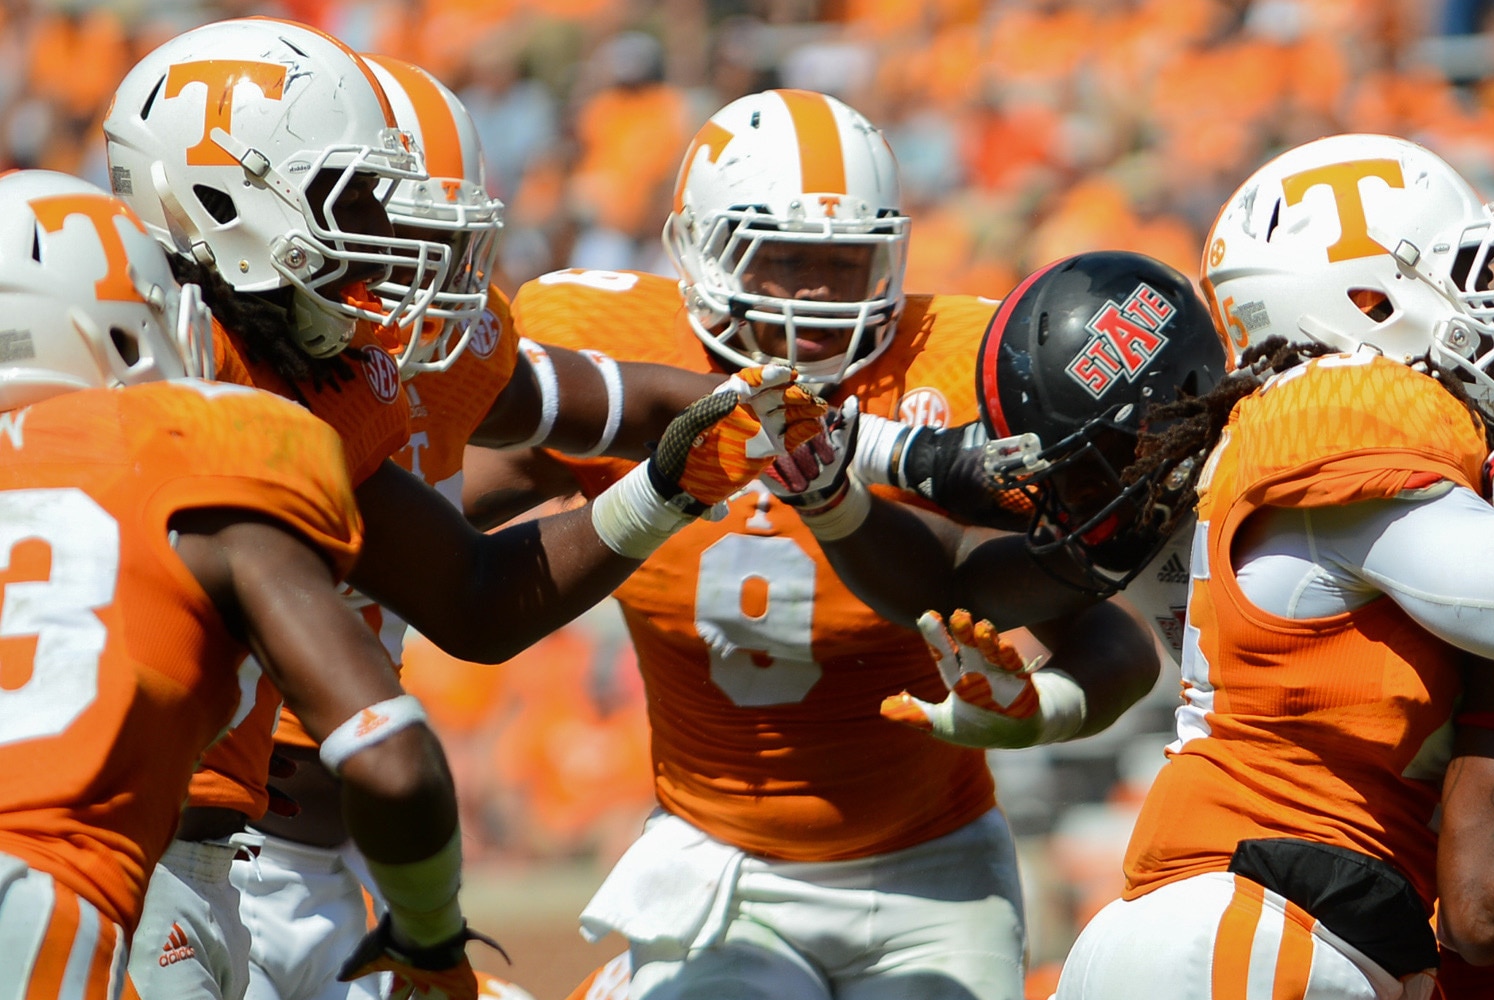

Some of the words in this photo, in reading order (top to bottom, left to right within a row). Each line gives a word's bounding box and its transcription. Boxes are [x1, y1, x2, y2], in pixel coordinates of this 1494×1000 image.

[165, 60, 287, 166] T
[441, 181, 461, 202] T
[818, 196, 840, 218] T
[1281, 158, 1405, 263] T
[28, 193, 150, 303] T
[368, 349, 397, 399] SEC
[1070, 285, 1174, 394] STATE
[1222, 296, 1249, 349] 5
[695, 532, 823, 708] 8
